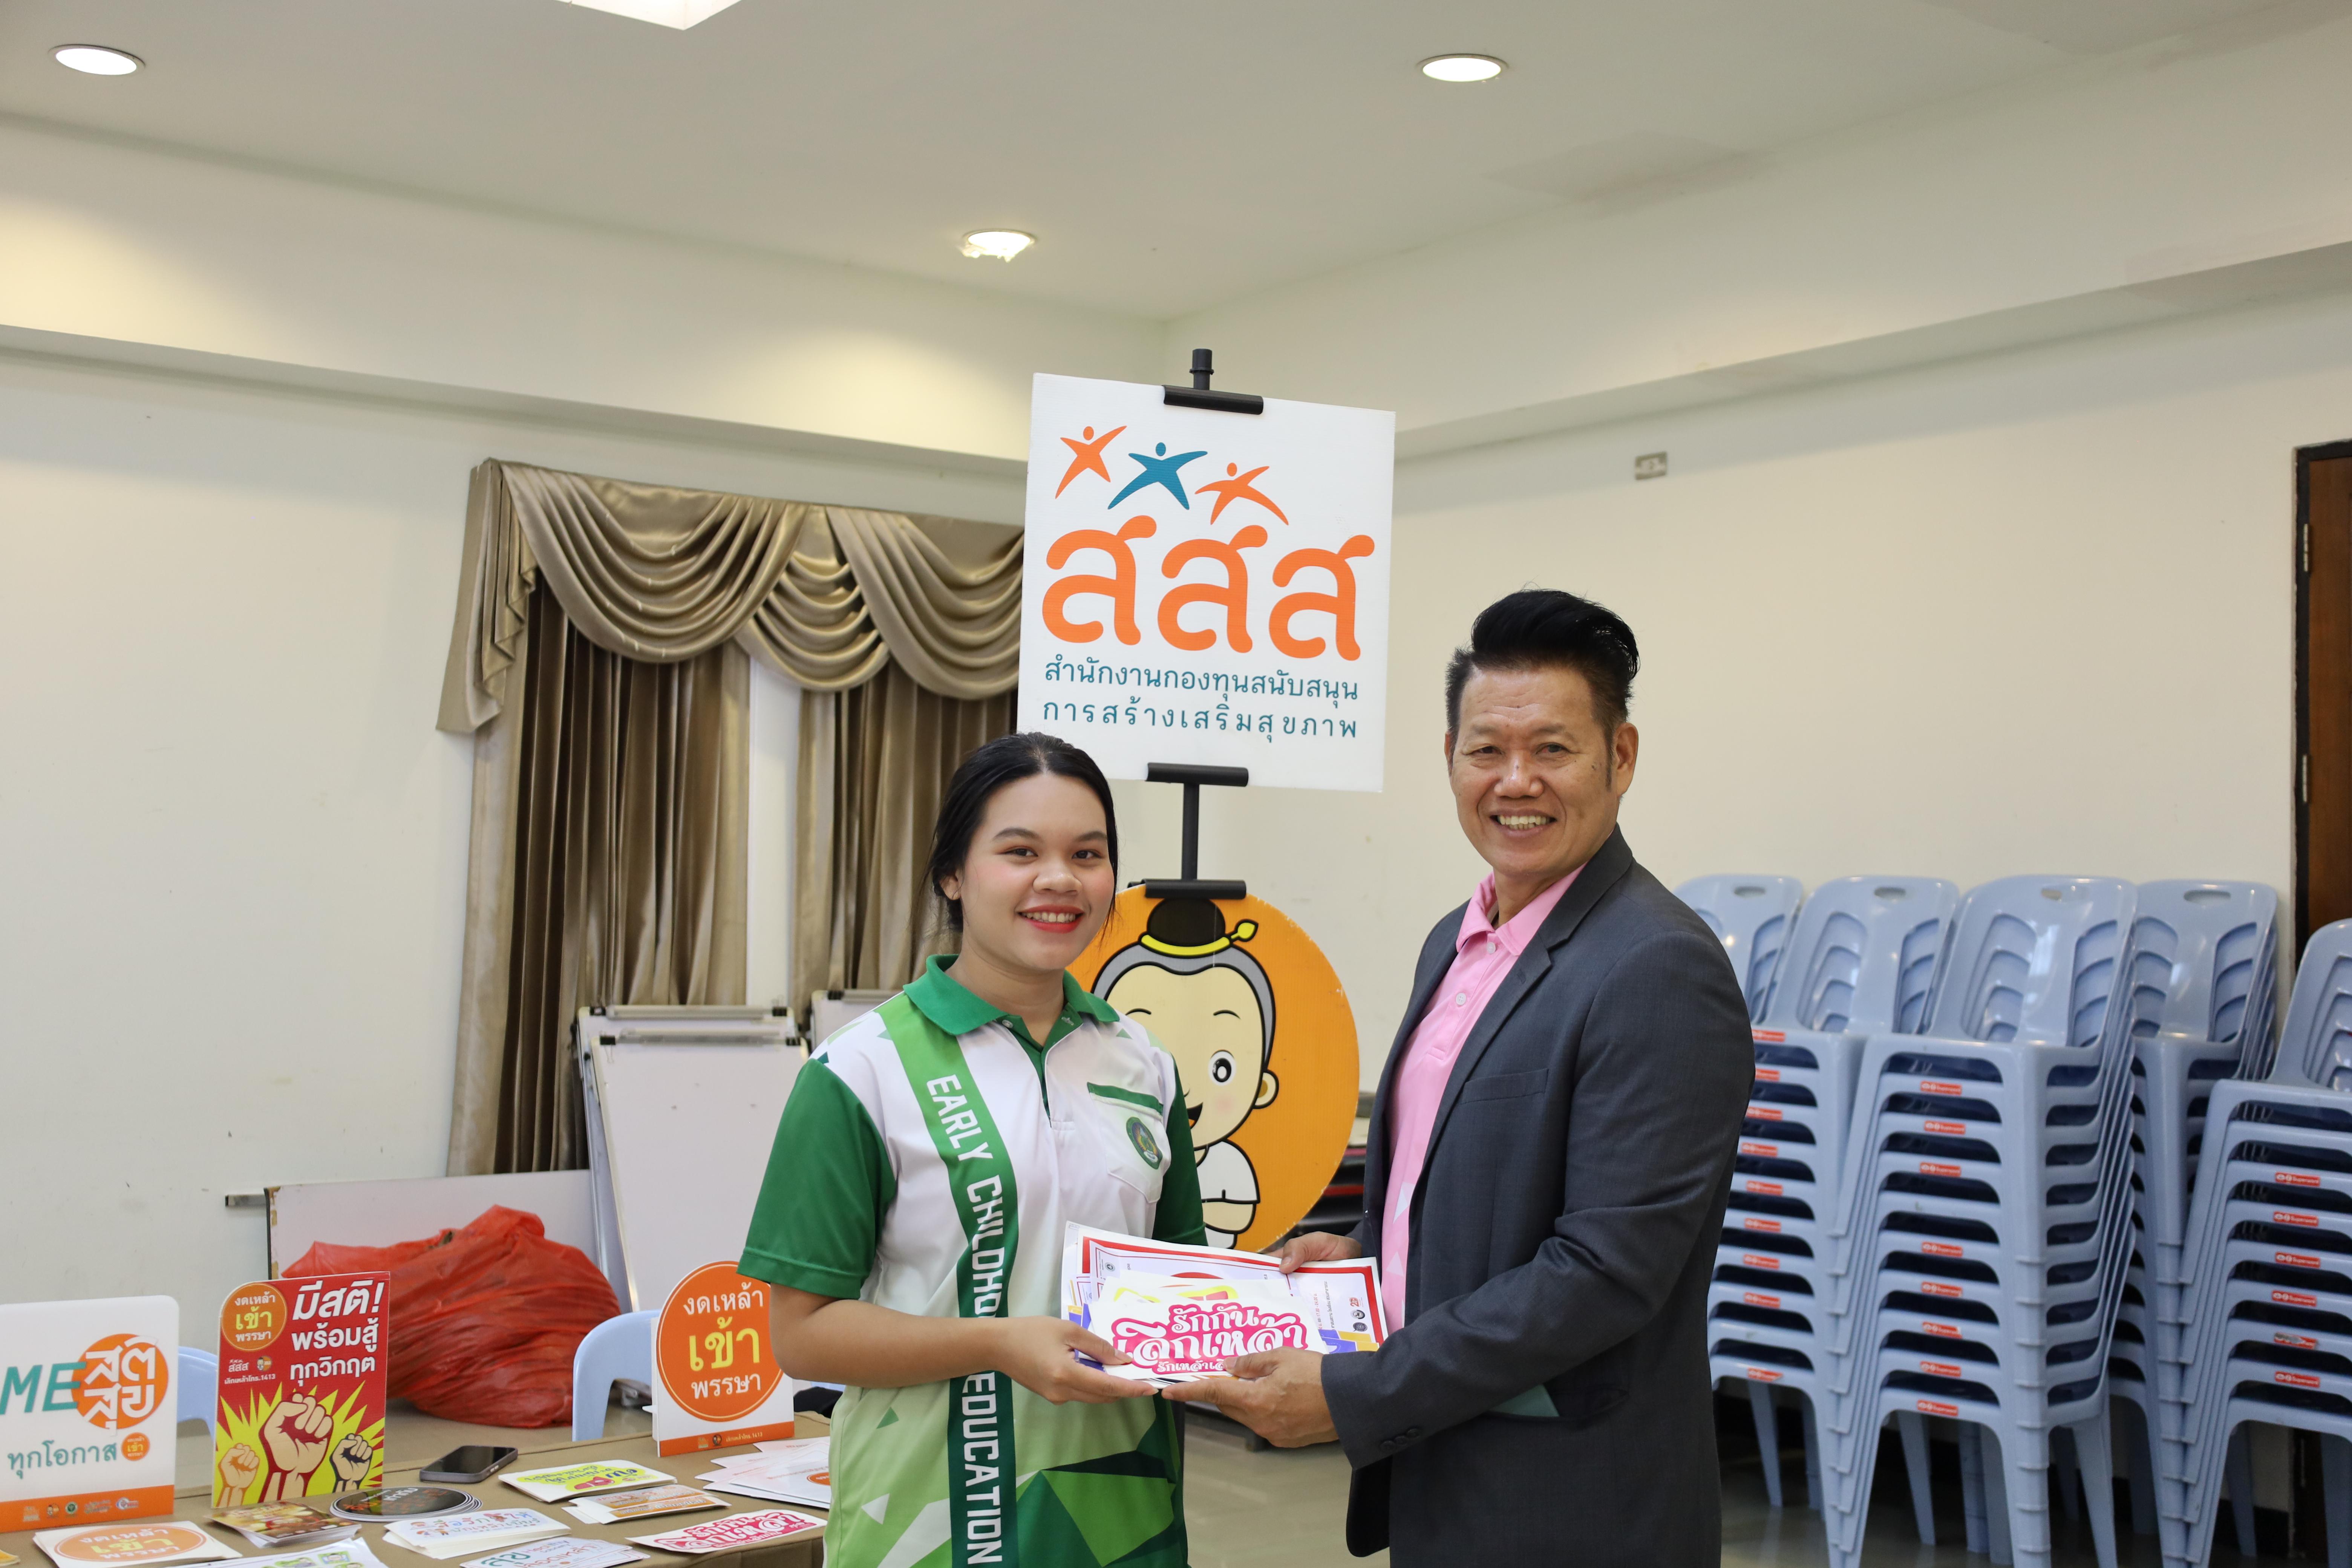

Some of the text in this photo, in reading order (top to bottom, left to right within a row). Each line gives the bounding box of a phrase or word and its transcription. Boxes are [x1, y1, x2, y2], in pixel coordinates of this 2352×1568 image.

[1042, 515, 1375, 661] สสส
[1045, 654, 1358, 709] สำนักงานกองทุนสนับสนุน
[1043, 696, 1357, 743] การสร้างเสริมสุขภาพ
[234, 1291, 276, 1306] งดเหล้า
[292, 1280, 384, 1320] มีสติ!
[683, 1282, 763, 1315] งดเหล้า
[235, 1306, 272, 1330] เข้า
[926, 1074, 1005, 1565] EARLY CHILDHO EDUCATION
[1171, 1305, 1259, 1333] รักกัน
[235, 1330, 271, 1342] พรรษา
[291, 1317, 379, 1353] พร้อมสู้
[689, 1316, 760, 1371] เข้า
[1116, 1315, 1303, 1367] เลิกเหล้า
[290, 1356, 375, 1387] ทุกวิกฤต
[1157, 1358, 1224, 1372] รักเหล้าเลิ
[0, 1361, 87, 1415] ME
[691, 1373, 761, 1399] พรรษา
[8, 1440, 117, 1479] ทุกโอกาส
[79, 1528, 169, 1543] งดเหล้า
[90, 1539, 174, 1553] เข้า
[100, 1546, 180, 1559] พรรษา
